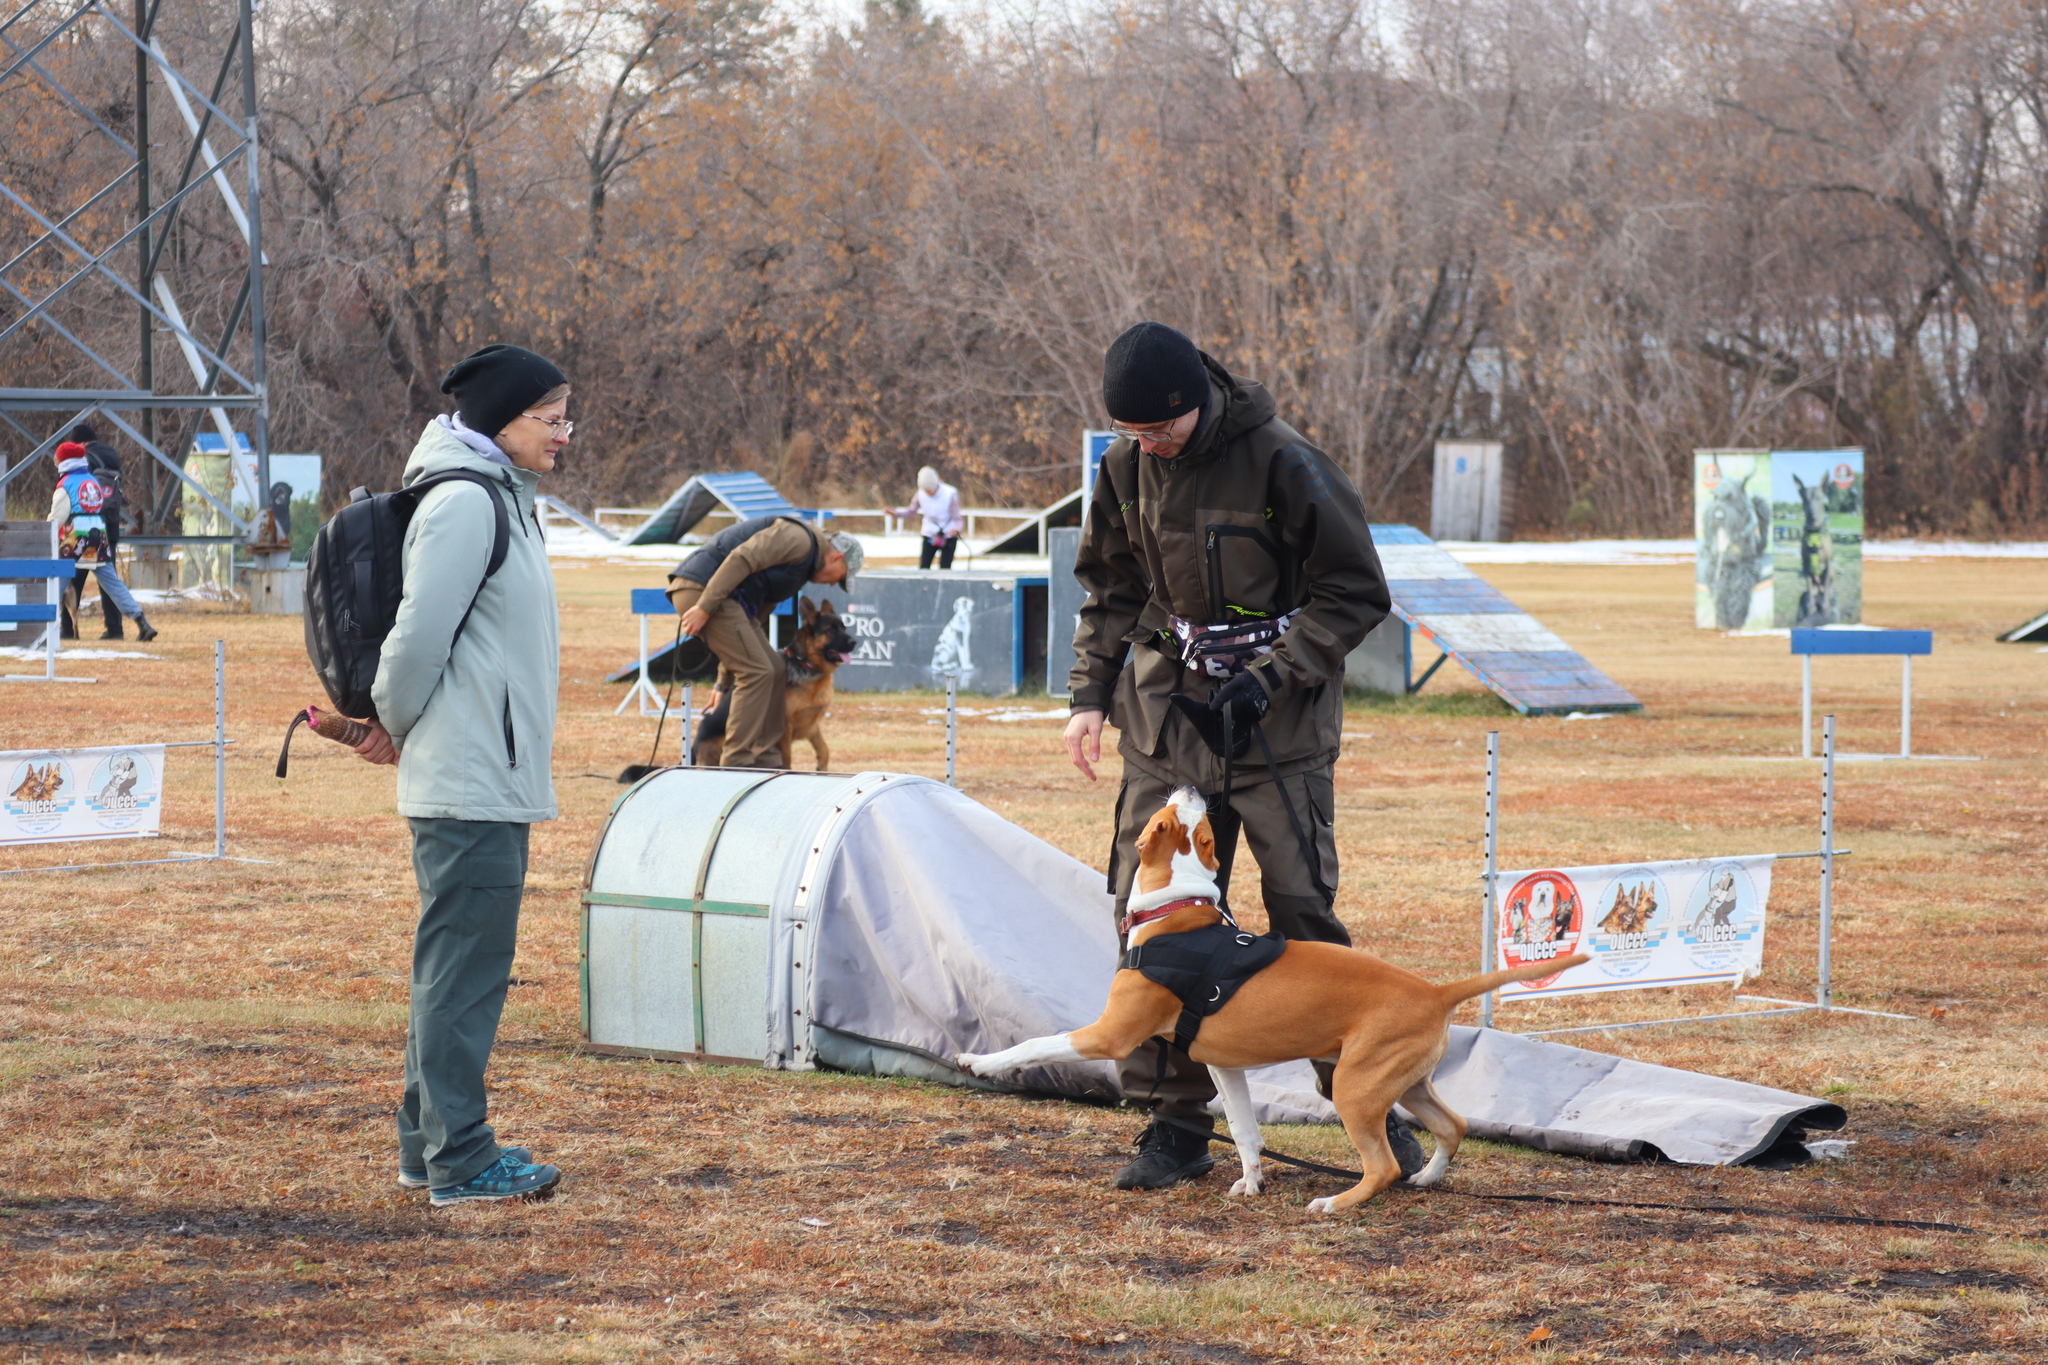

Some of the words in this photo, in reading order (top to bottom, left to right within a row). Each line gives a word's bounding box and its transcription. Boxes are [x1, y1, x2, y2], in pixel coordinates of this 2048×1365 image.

[840, 613, 885, 637] PRO
[22, 800, 57, 814] ОЦССС
[1519, 941, 1557, 961] ОЦССС
[1610, 932, 1648, 951] ОЦССС
